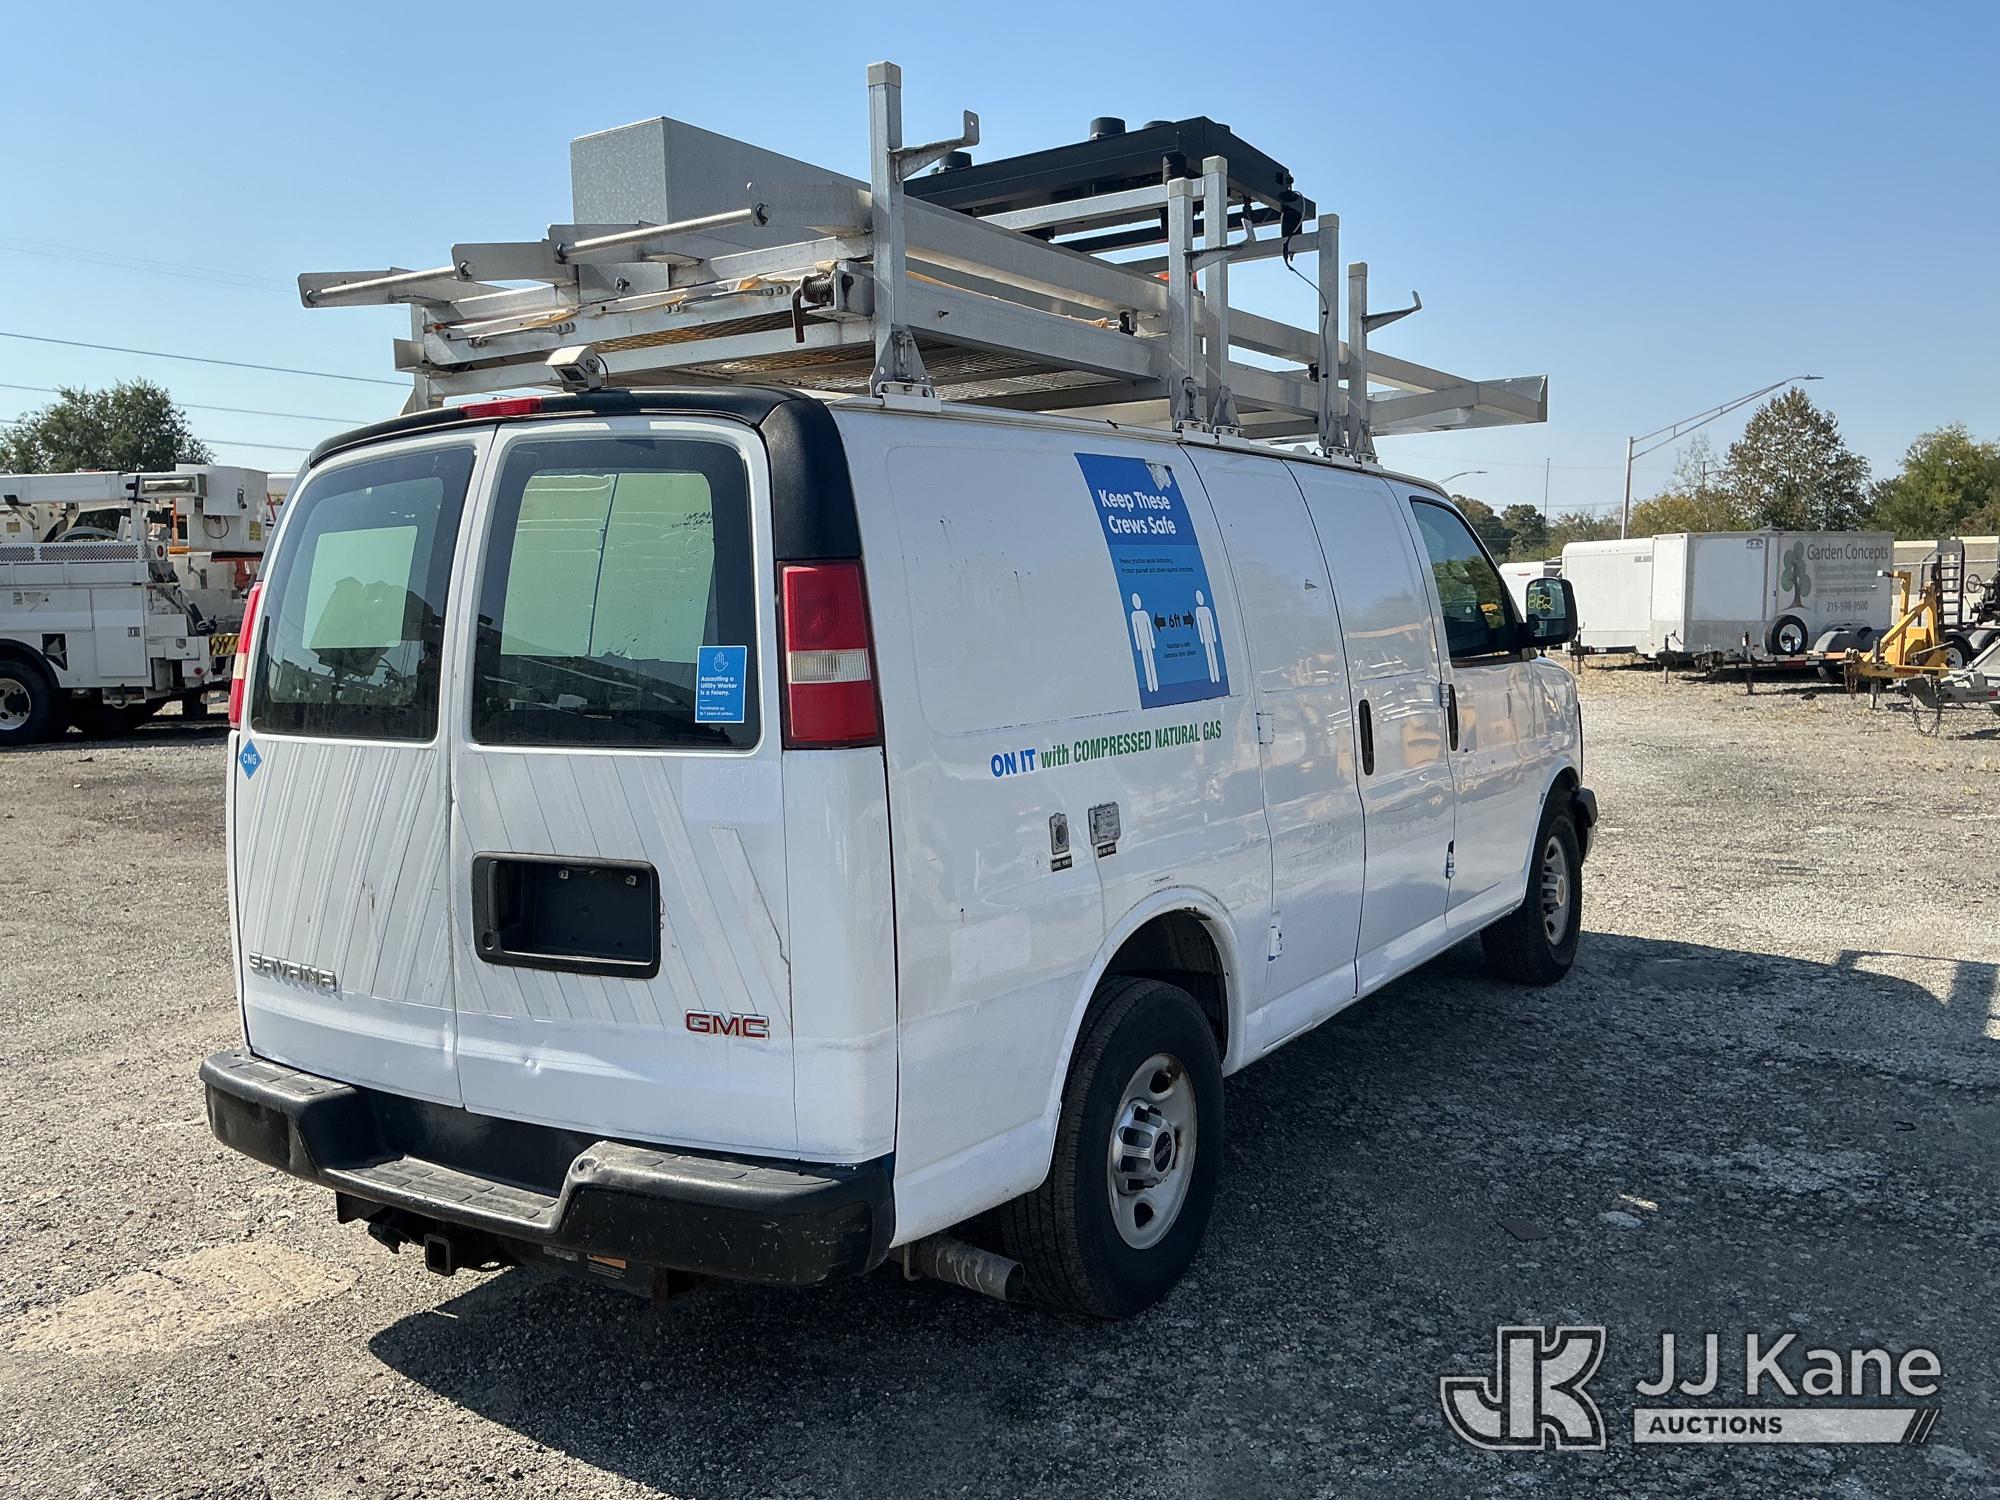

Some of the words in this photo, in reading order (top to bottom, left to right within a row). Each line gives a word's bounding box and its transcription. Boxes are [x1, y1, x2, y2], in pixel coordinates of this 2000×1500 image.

[1098, 489, 1134, 512] Keep
[1133, 491, 1171, 510] These
[1108, 514, 1148, 534] Crews
[1148, 515, 1177, 535] Safe
[1807, 543, 1843, 560] Garden
[1845, 543, 1889, 563] Concepts
[1169, 613, 1181, 628] 6ft
[243, 752, 257, 765] CNG
[990, 752, 1017, 778] ON
[1020, 748, 1036, 772] IT
[1041, 744, 1069, 769] with
[1073, 730, 1152, 763] COMPRESSED
[1155, 723, 1201, 748] NATURAL
[1203, 719, 1222, 741] GAS
[685, 1008, 770, 1040] GMC
